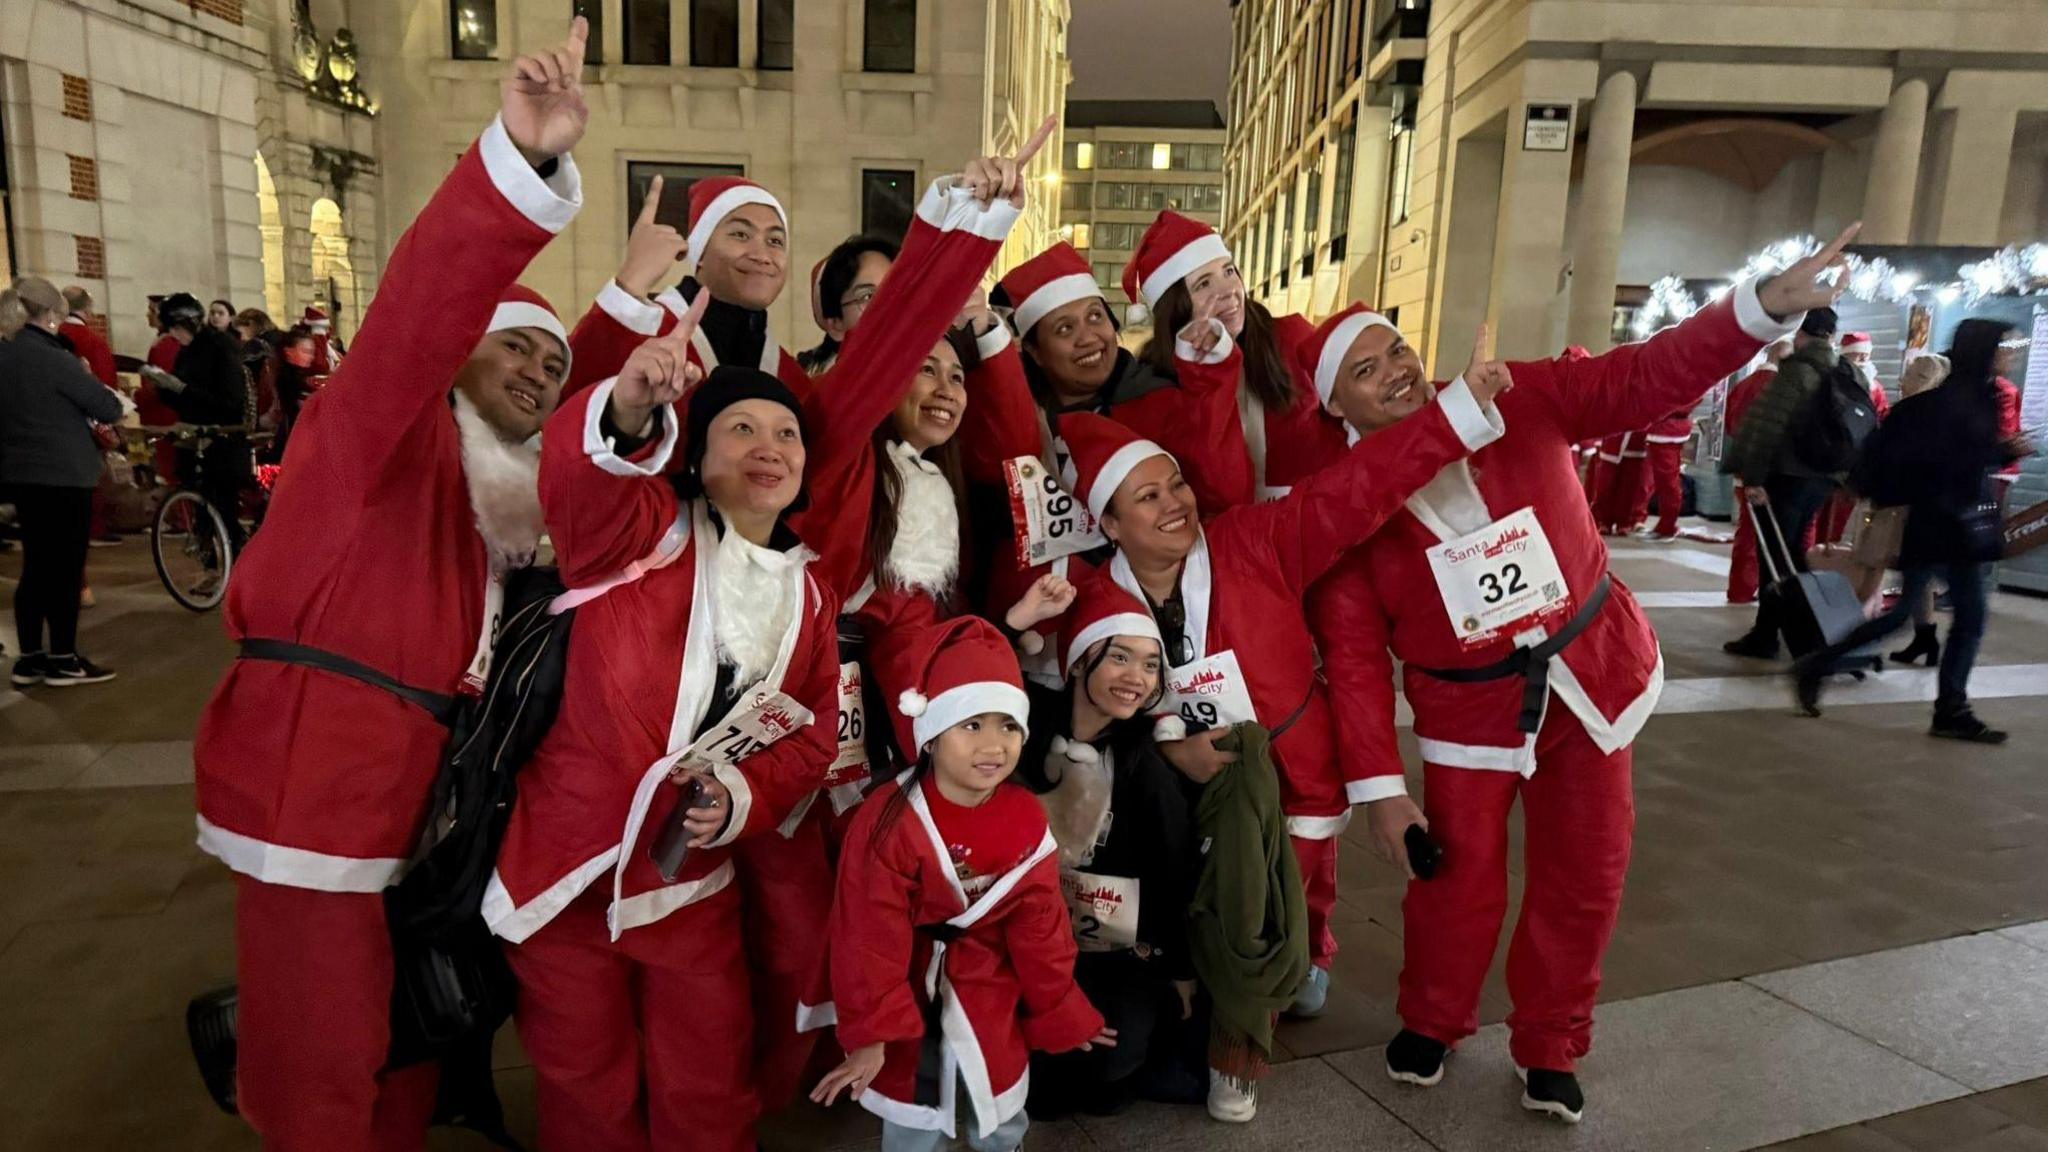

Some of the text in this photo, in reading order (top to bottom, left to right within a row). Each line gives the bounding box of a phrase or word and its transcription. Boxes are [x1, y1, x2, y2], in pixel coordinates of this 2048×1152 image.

[1448, 540, 1488, 563] Santa
[1505, 539, 1526, 553] City
[1478, 563, 1528, 604] 32
[1199, 683, 1222, 695] City
[1094, 900, 1117, 915] City
